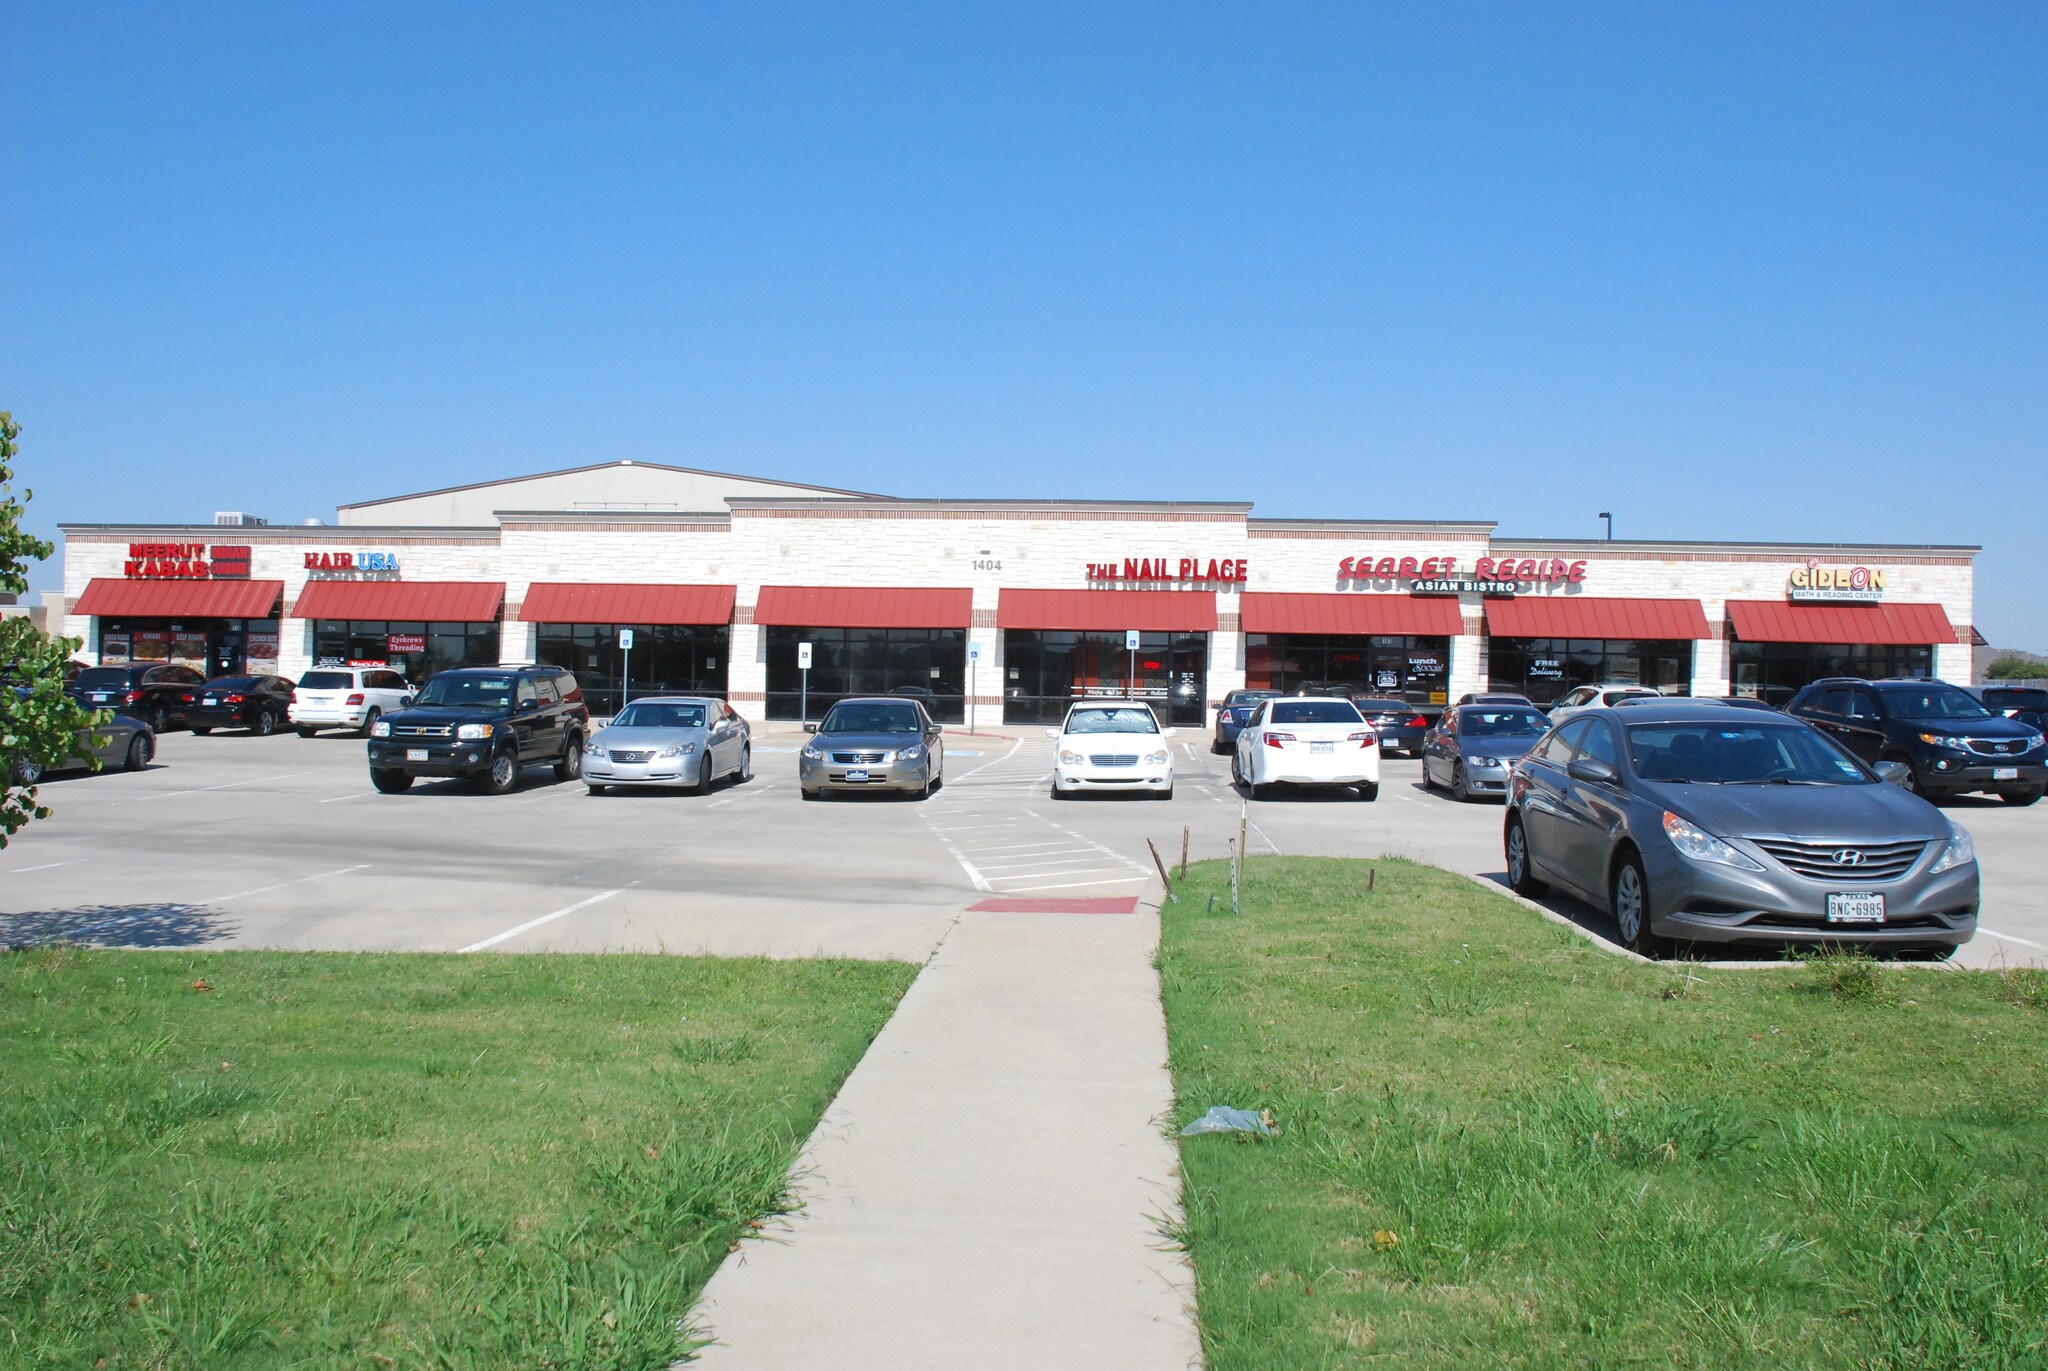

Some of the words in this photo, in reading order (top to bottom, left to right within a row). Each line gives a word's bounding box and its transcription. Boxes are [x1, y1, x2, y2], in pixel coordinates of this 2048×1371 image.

[129, 543, 205, 558] MEERUT
[211, 545, 251, 560] INDIAN
[124, 561, 208, 577] KABAB
[210, 561, 250, 576] CUISINE
[304, 553, 353, 570] HAIR
[357, 553, 399, 570] USA
[971, 560, 1002, 570] 1404
[1086, 563, 1118, 580] THE
[1124, 558, 1173, 581] NAIL
[1179, 558, 1247, 582] PLACE
[1337, 556, 1457, 580] SECRET
[1475, 557, 1588, 583] RECIPE
[1790, 558, 1887, 589] GIDEON
[1415, 580, 1459, 591] ASIAN
[1464, 581, 1516, 592] BISTRO
[390, 644, 424, 652] Threading
[1412, 663, 1444, 673] Special
[1529, 667, 1563, 678] Delivery
